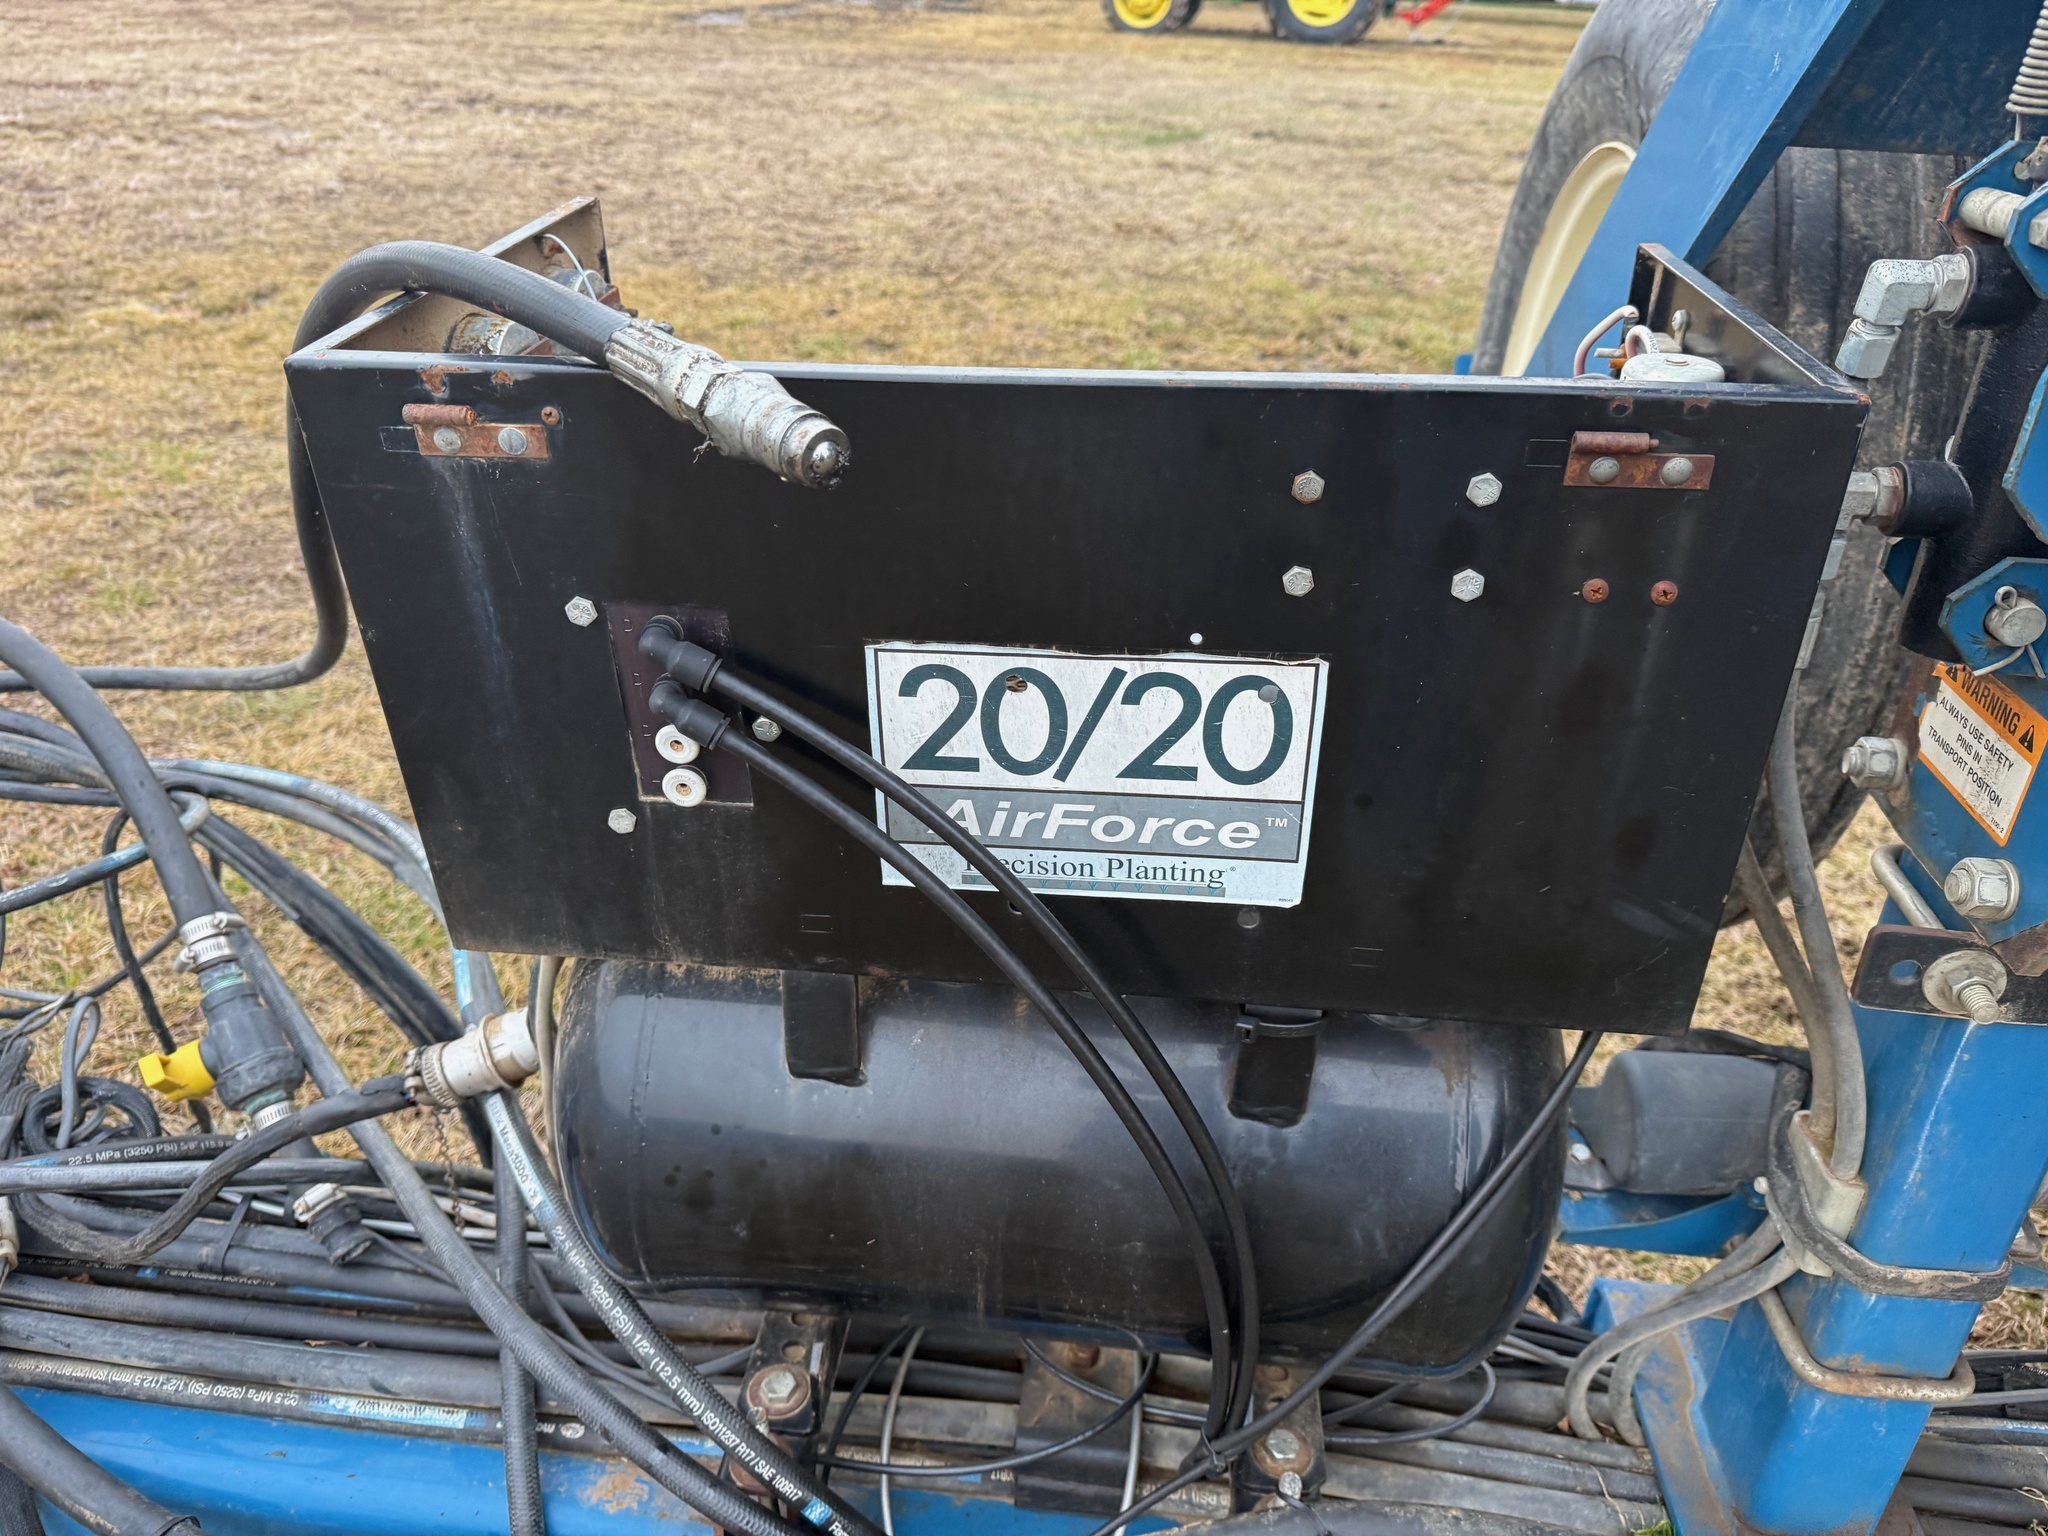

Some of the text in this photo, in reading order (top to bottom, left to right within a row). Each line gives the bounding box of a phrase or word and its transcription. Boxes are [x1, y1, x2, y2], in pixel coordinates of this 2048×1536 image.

[1961, 672, 2021, 737] WARNING
[898, 664, 1293, 786] 20/20
[1940, 696, 2015, 772] ALWAYS USE SAFETY
[1956, 733, 1983, 765] PINS IN
[1928, 725, 2003, 808] TRANSPORT POSITION
[68, 1155, 93, 1166] 22.5
[95, 1150, 121, 1162] MPa
[123, 1145, 154, 1159] (3250
[156, 1142, 178, 1155] PSI)
[108, 1369, 133, 1383] mm)
[134, 1373, 163, 1390] (12.5
[162, 1378, 184, 1393] 1/2"
[187, 1379, 212, 1396] PSI)
[213, 1384, 246, 1400] (3250
[247, 1388, 273, 1404] MPa
[609, 1304, 635, 1338] PSI)
[632, 1331, 656, 1358] 1/2"
[649, 1354, 682, 1390] (12.5
[676, 1381, 706, 1417] mm)
[700, 1409, 739, 1453] ISO11237
[734, 1441, 756, 1464] R17
[753, 1459, 776, 1482] SAE
[771, 1475, 803, 1502] 100R17
